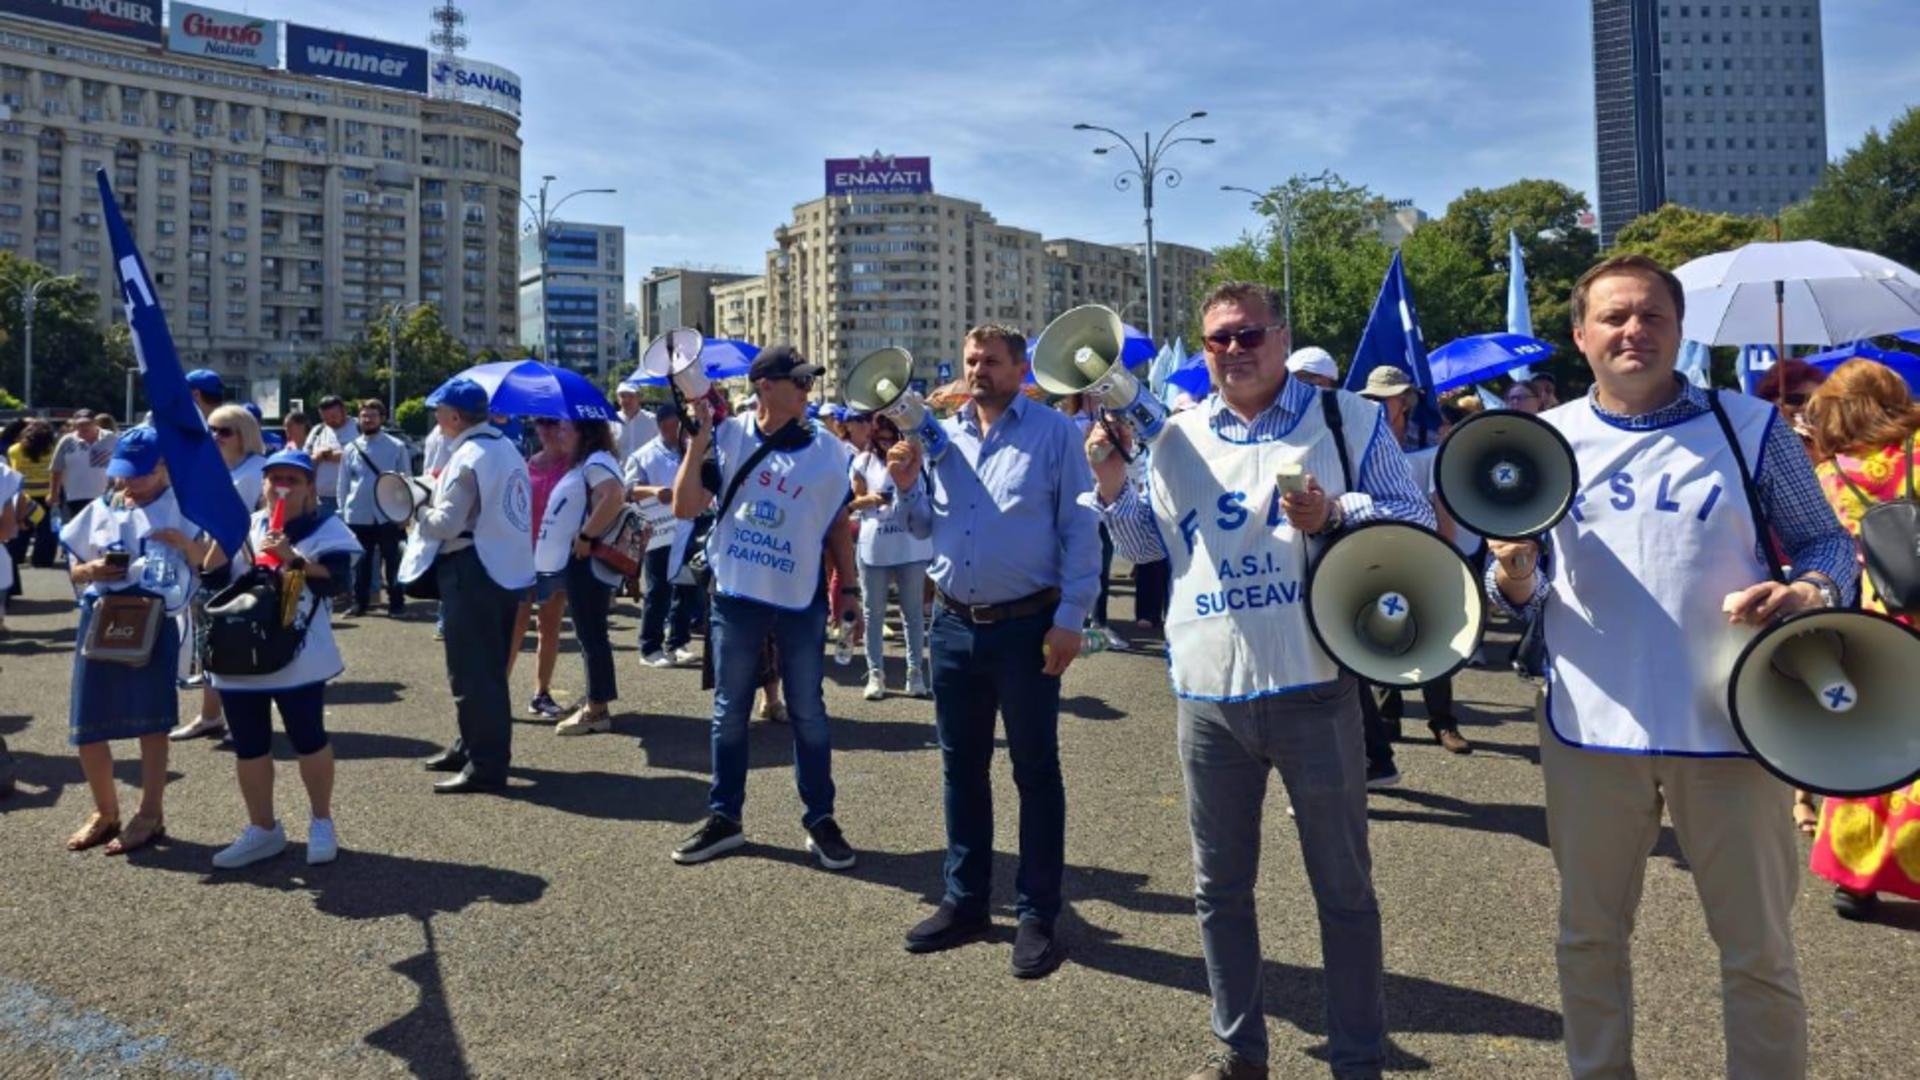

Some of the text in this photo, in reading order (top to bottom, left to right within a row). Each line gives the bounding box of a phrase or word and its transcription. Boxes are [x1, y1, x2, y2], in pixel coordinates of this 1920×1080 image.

[183, 12, 263, 46] Giusto
[204, 40, 257, 58] Natura
[306, 42, 408, 77] winner
[834, 171, 922, 186] ENAYATI
[575, 404, 608, 419] FSLI
[1218, 552, 1281, 580] A.S.I.
